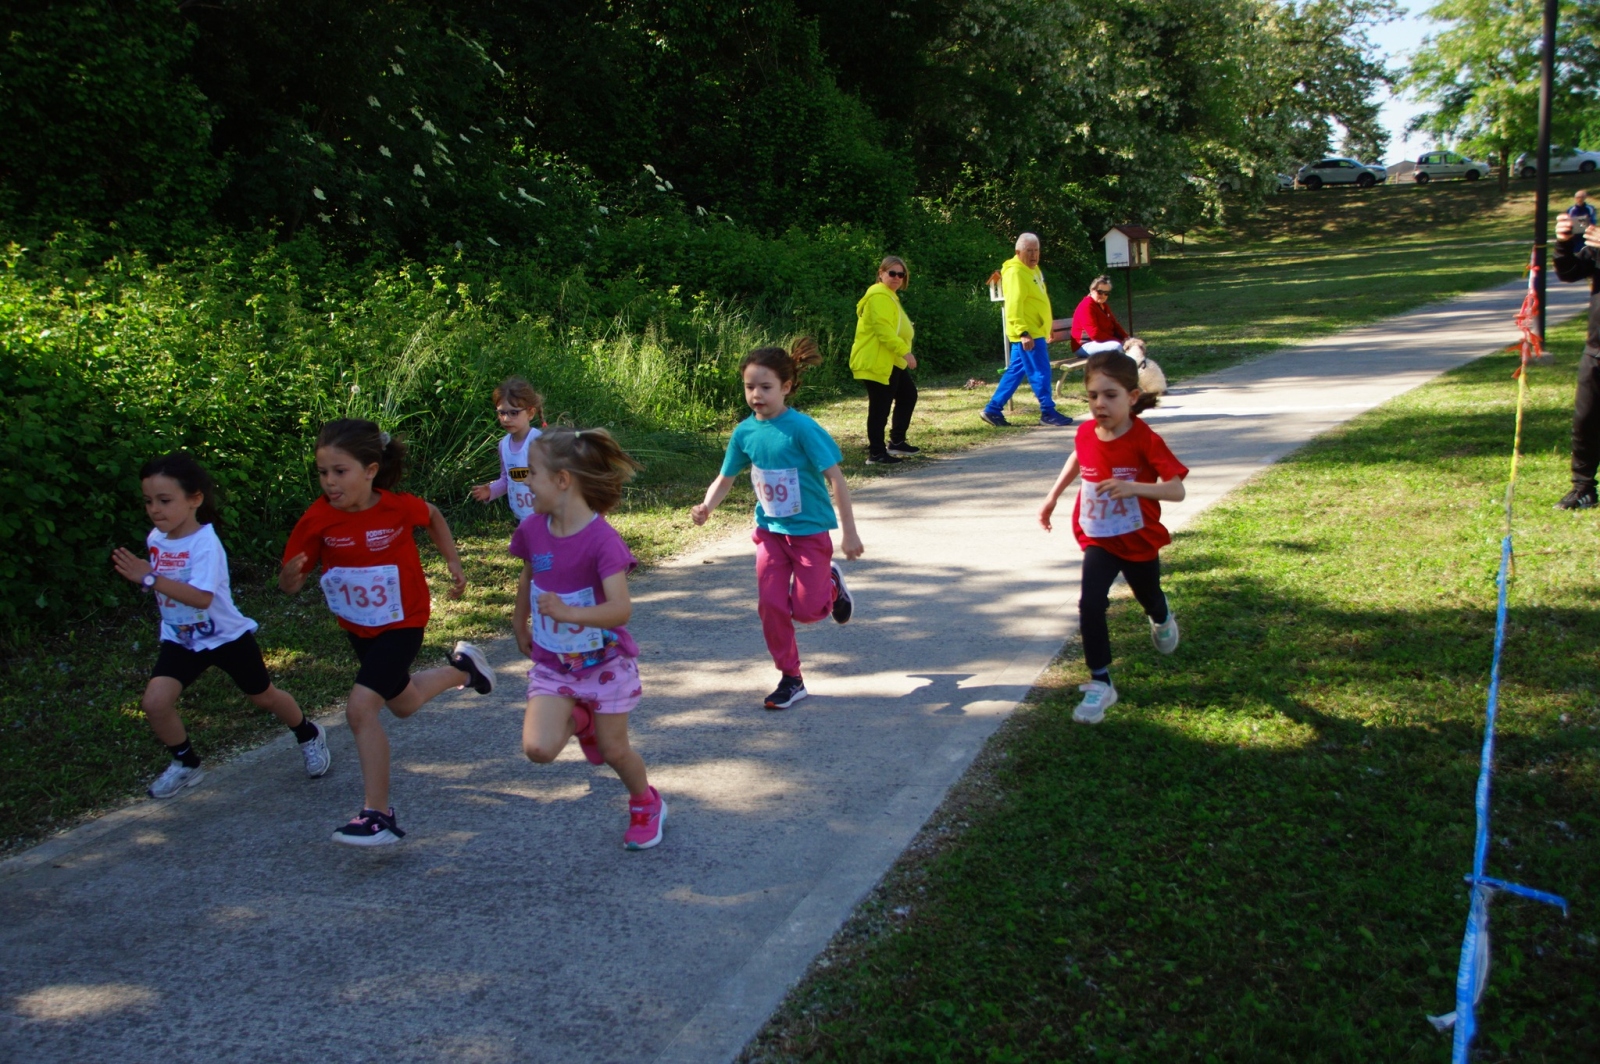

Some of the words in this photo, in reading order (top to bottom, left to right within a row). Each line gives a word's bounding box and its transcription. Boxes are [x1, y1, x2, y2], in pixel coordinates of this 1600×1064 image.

[1085, 497, 1129, 521] 274
[366, 528, 395, 538] PODISTICA
[338, 584, 388, 608] 133
